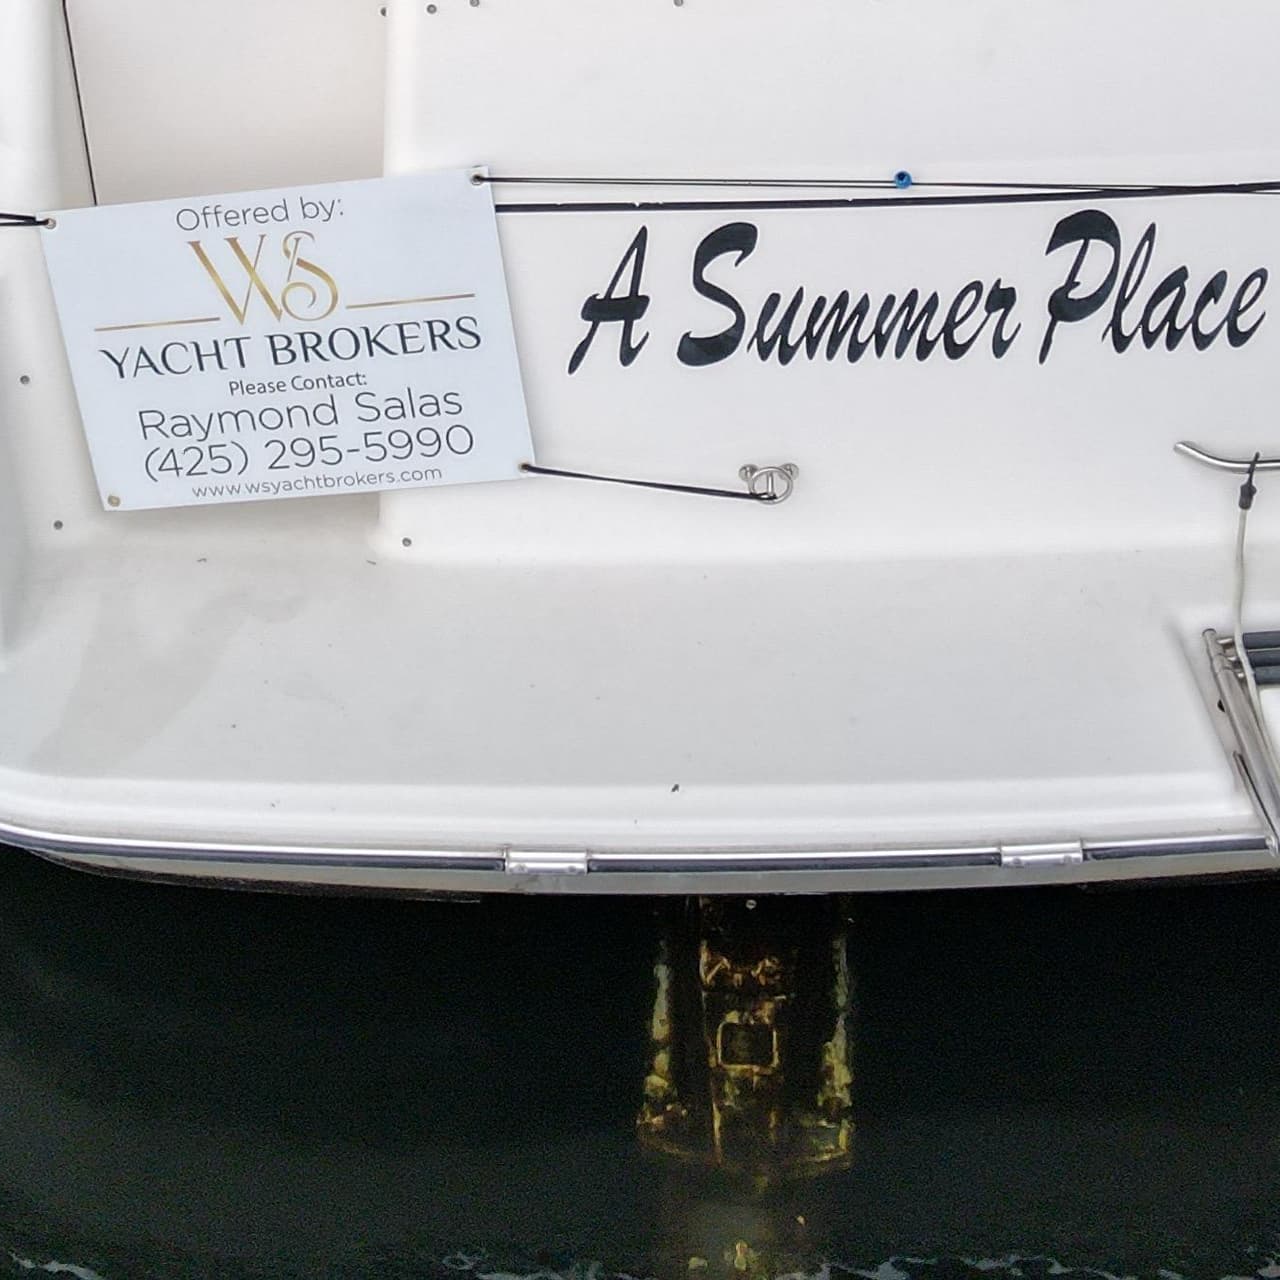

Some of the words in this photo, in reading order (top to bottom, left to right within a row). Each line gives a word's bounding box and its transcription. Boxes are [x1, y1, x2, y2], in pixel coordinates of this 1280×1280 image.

[175, 198, 289, 232] Offered
[300, 196, 345, 223] by:
[187, 230, 339, 325] WS
[569, 225, 651, 375] A
[676, 221, 1022, 367] Summer
[1038, 208, 1269, 365] Place
[99, 336, 252, 379] YACHT
[264, 315, 482, 366] BROKERS
[229, 379, 287, 396] Please
[291, 371, 368, 392] Contact:
[139, 394, 339, 442] Raymond
[355, 387, 463, 423] Salas
[145, 441, 249, 482] (425)
[265, 424, 474, 470] 295-5990
[192, 467, 443, 498] www.wsyachtbrokers.com
